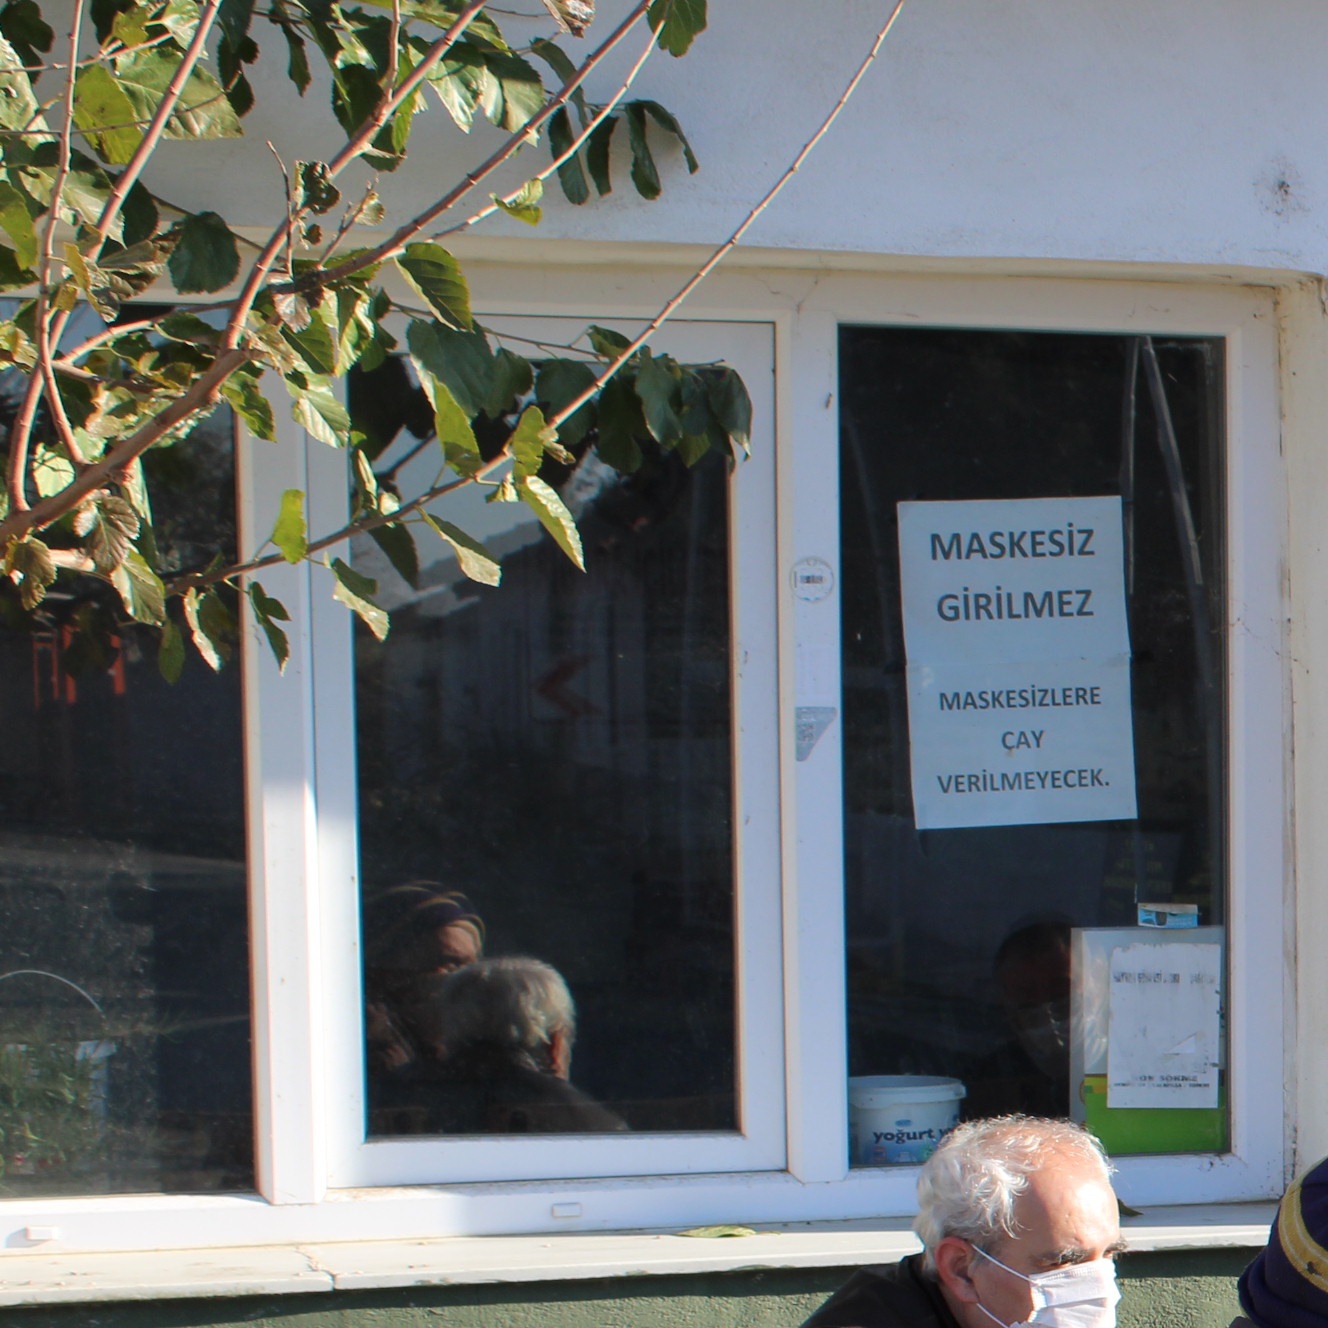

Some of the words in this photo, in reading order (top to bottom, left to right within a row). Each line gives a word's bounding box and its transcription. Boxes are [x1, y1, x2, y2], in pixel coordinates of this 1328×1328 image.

[929, 522, 1096, 561] MASKESİZ
[936, 586, 1095, 622] GİRİLMEZ
[939, 684, 1102, 711] MASKESİZLERE
[1001, 729, 1046, 755] ÇAY
[936, 768, 1111, 794] VERİLMEYECEK.
[872, 1128, 936, 1145] yoğurt
